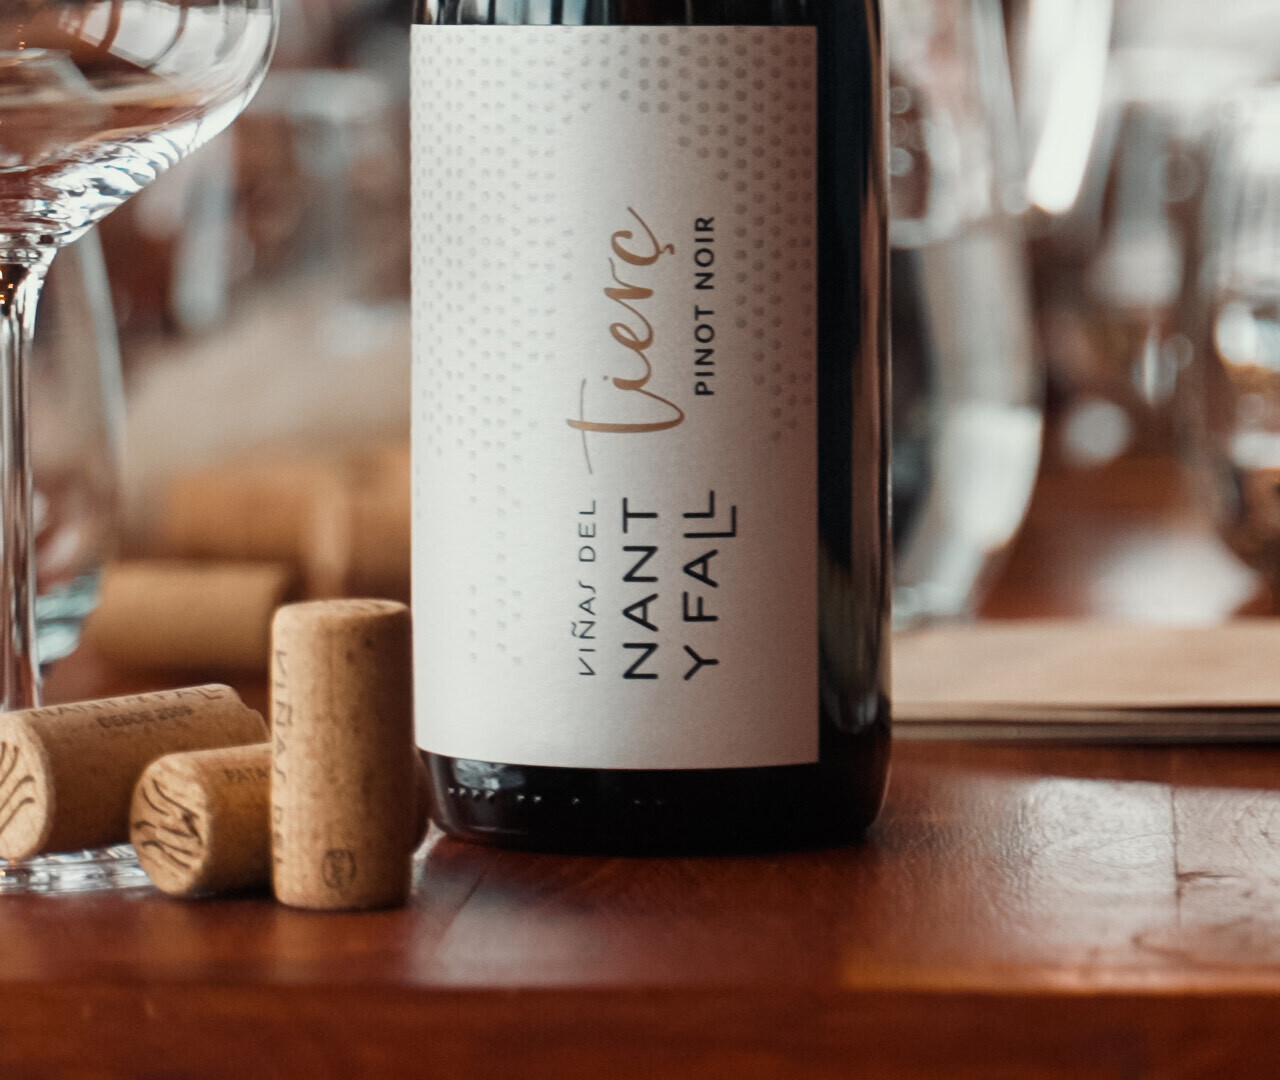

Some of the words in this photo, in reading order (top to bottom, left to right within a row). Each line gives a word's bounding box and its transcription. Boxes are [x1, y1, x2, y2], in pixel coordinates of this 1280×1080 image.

[694, 217, 715, 290] NOIR
[694, 305, 715, 396] PINOT
[578, 500, 596, 562] DEL
[682, 490, 737, 622] FALL
[571, 581, 596, 676] VIÑAS
[621, 497, 660, 680] NANT
[683, 645, 720, 681] Y
